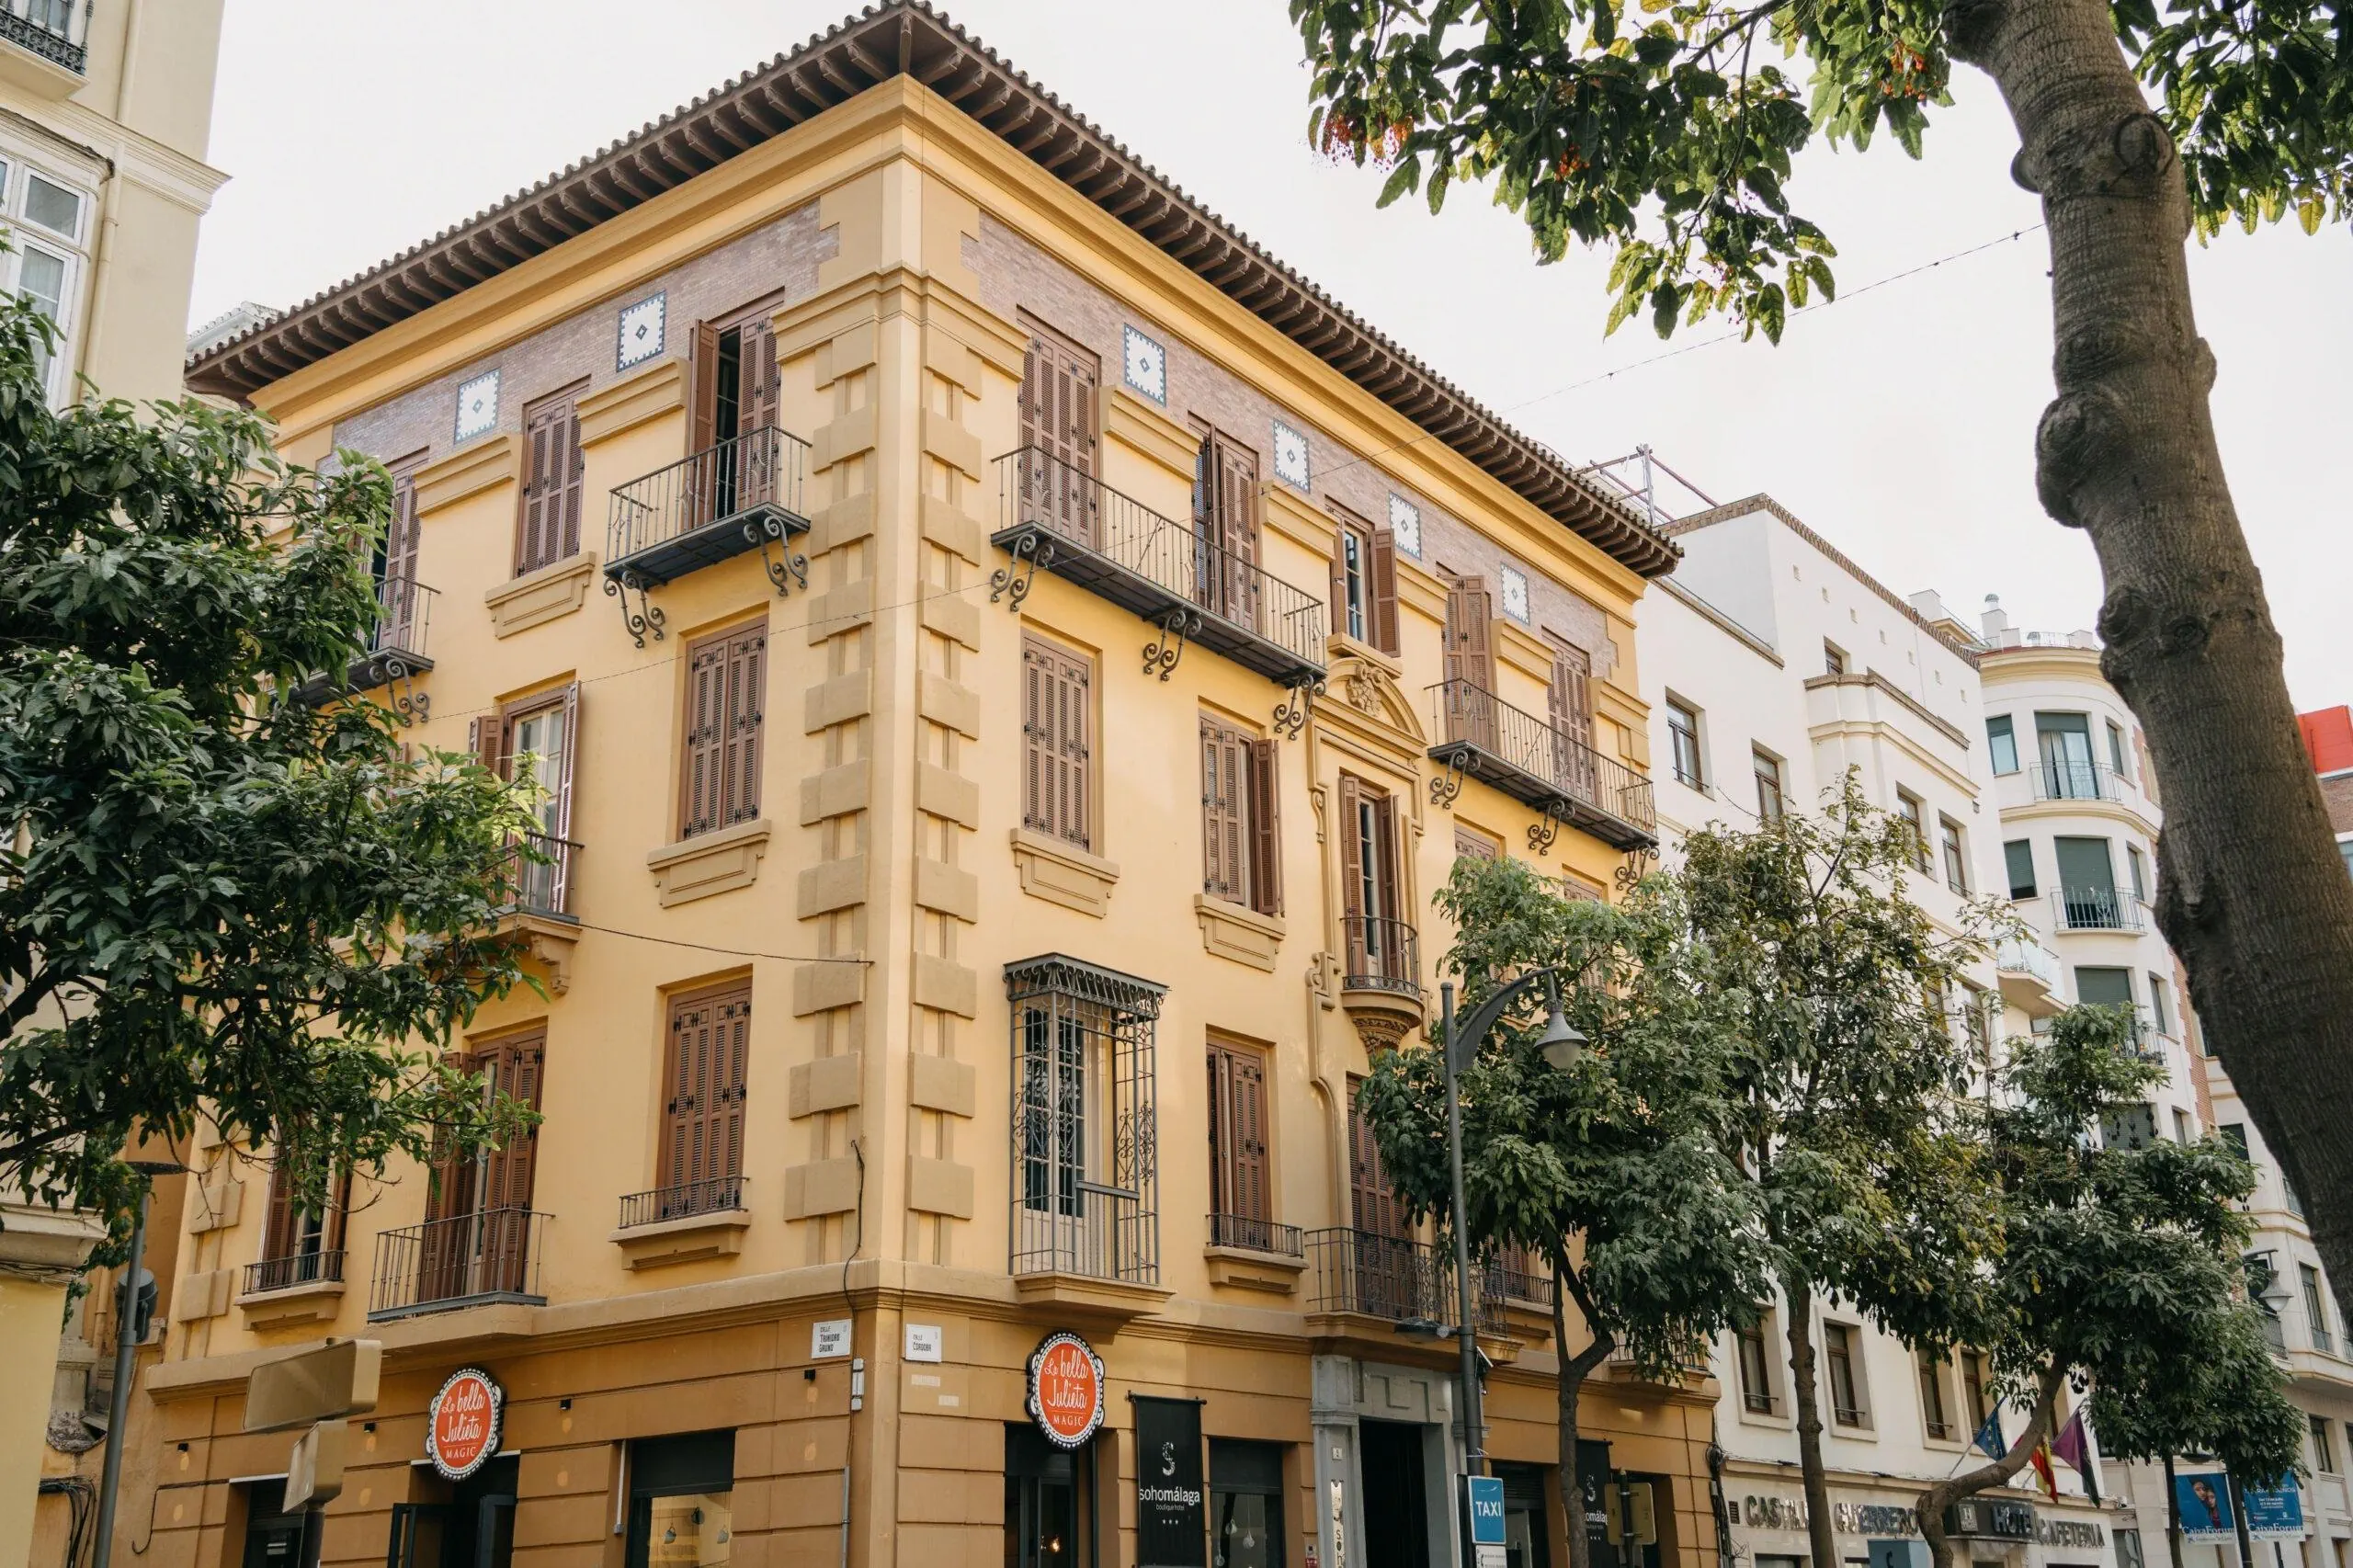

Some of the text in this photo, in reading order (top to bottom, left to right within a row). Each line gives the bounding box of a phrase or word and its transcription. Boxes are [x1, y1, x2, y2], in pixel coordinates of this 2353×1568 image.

[1044, 1349, 1089, 1380] La bella
[441, 1381, 485, 1414] La bella
[1046, 1379, 1088, 1409] Julieta
[441, 1414, 483, 1442] Julieta
[1052, 1415, 1085, 1426] MAGIC
[445, 1446, 477, 1459] MAGIC
[1139, 1485, 1200, 1506] sohomálaga
[1475, 1500, 1502, 1517] TAXI
[2248, 1523, 2302, 1532] CaixaForum
